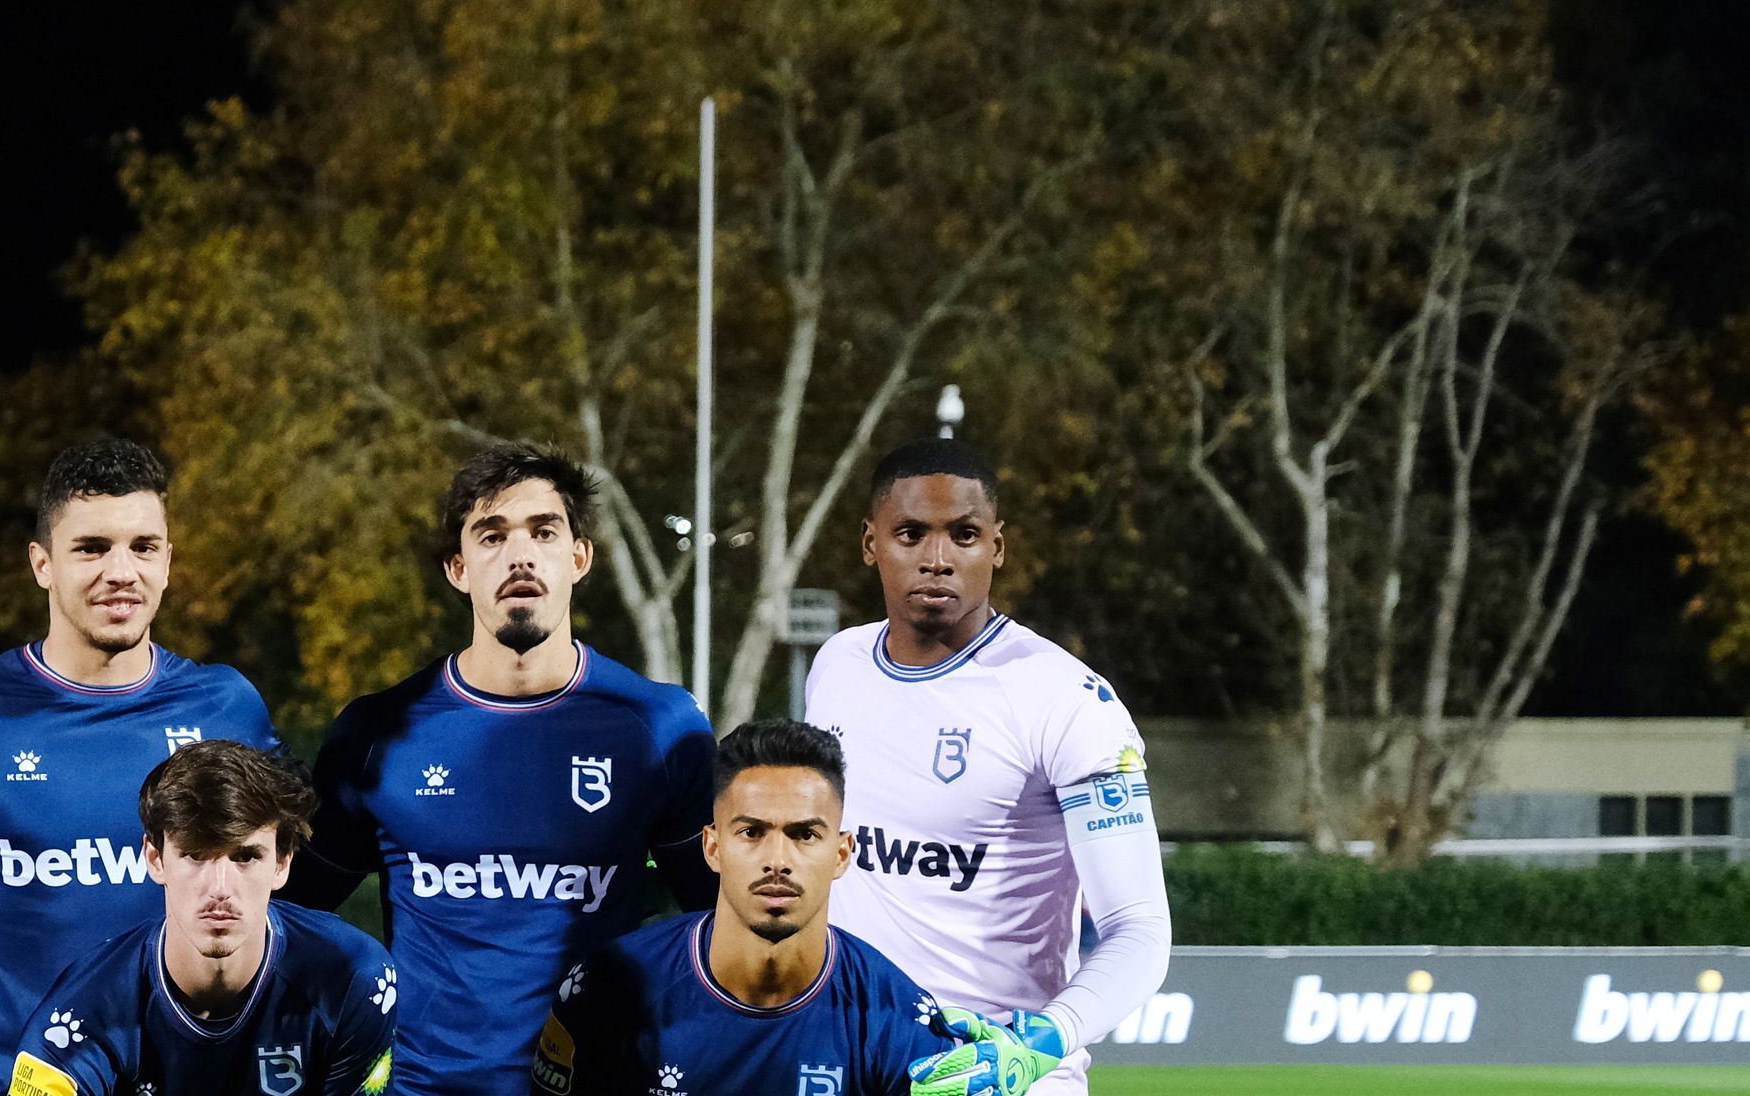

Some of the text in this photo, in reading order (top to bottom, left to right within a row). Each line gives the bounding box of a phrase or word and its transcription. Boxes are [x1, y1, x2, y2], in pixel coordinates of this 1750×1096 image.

[7, 773, 47, 781] KELME
[415, 788, 456, 796] KELME
[1087, 812, 1144, 832] CAPITÃO
[852, 825, 989, 892] tway
[407, 852, 618, 913] betway
[1284, 969, 1477, 1044] bwin
[17, 1062, 34, 1080] LIGA
